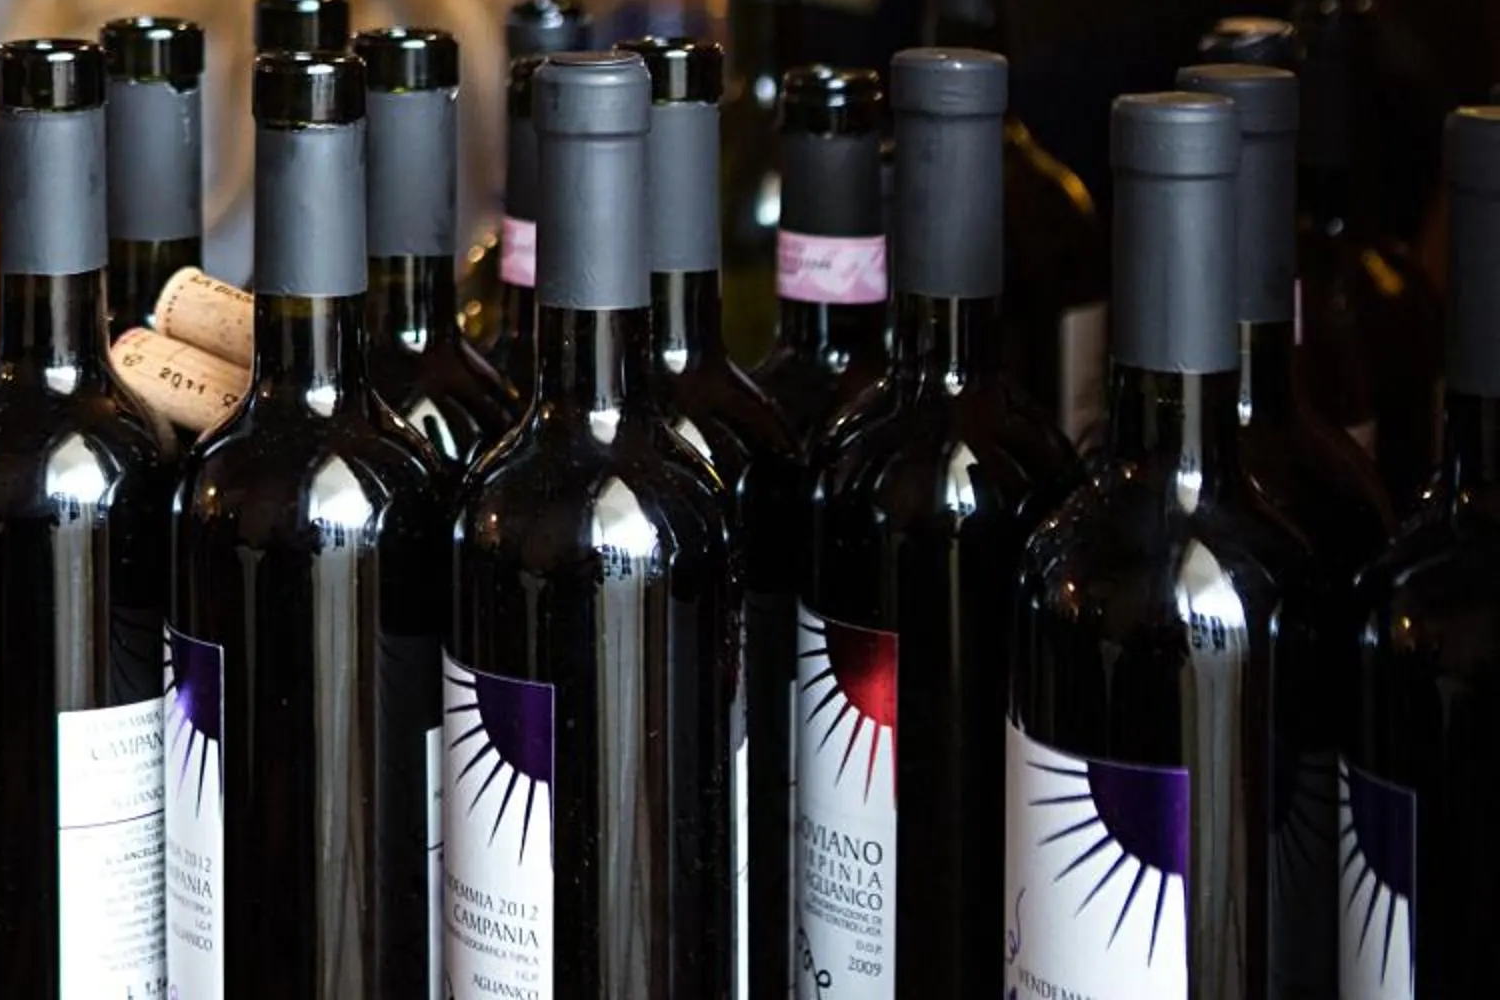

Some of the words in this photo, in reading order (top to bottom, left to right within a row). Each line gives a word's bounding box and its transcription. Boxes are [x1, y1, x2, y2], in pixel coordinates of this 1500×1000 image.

[159, 367, 207, 395] 2011
[184, 848, 213, 873] 2012
[498, 897, 539, 921] 2012
[452, 903, 540, 949] CAMPANIA
